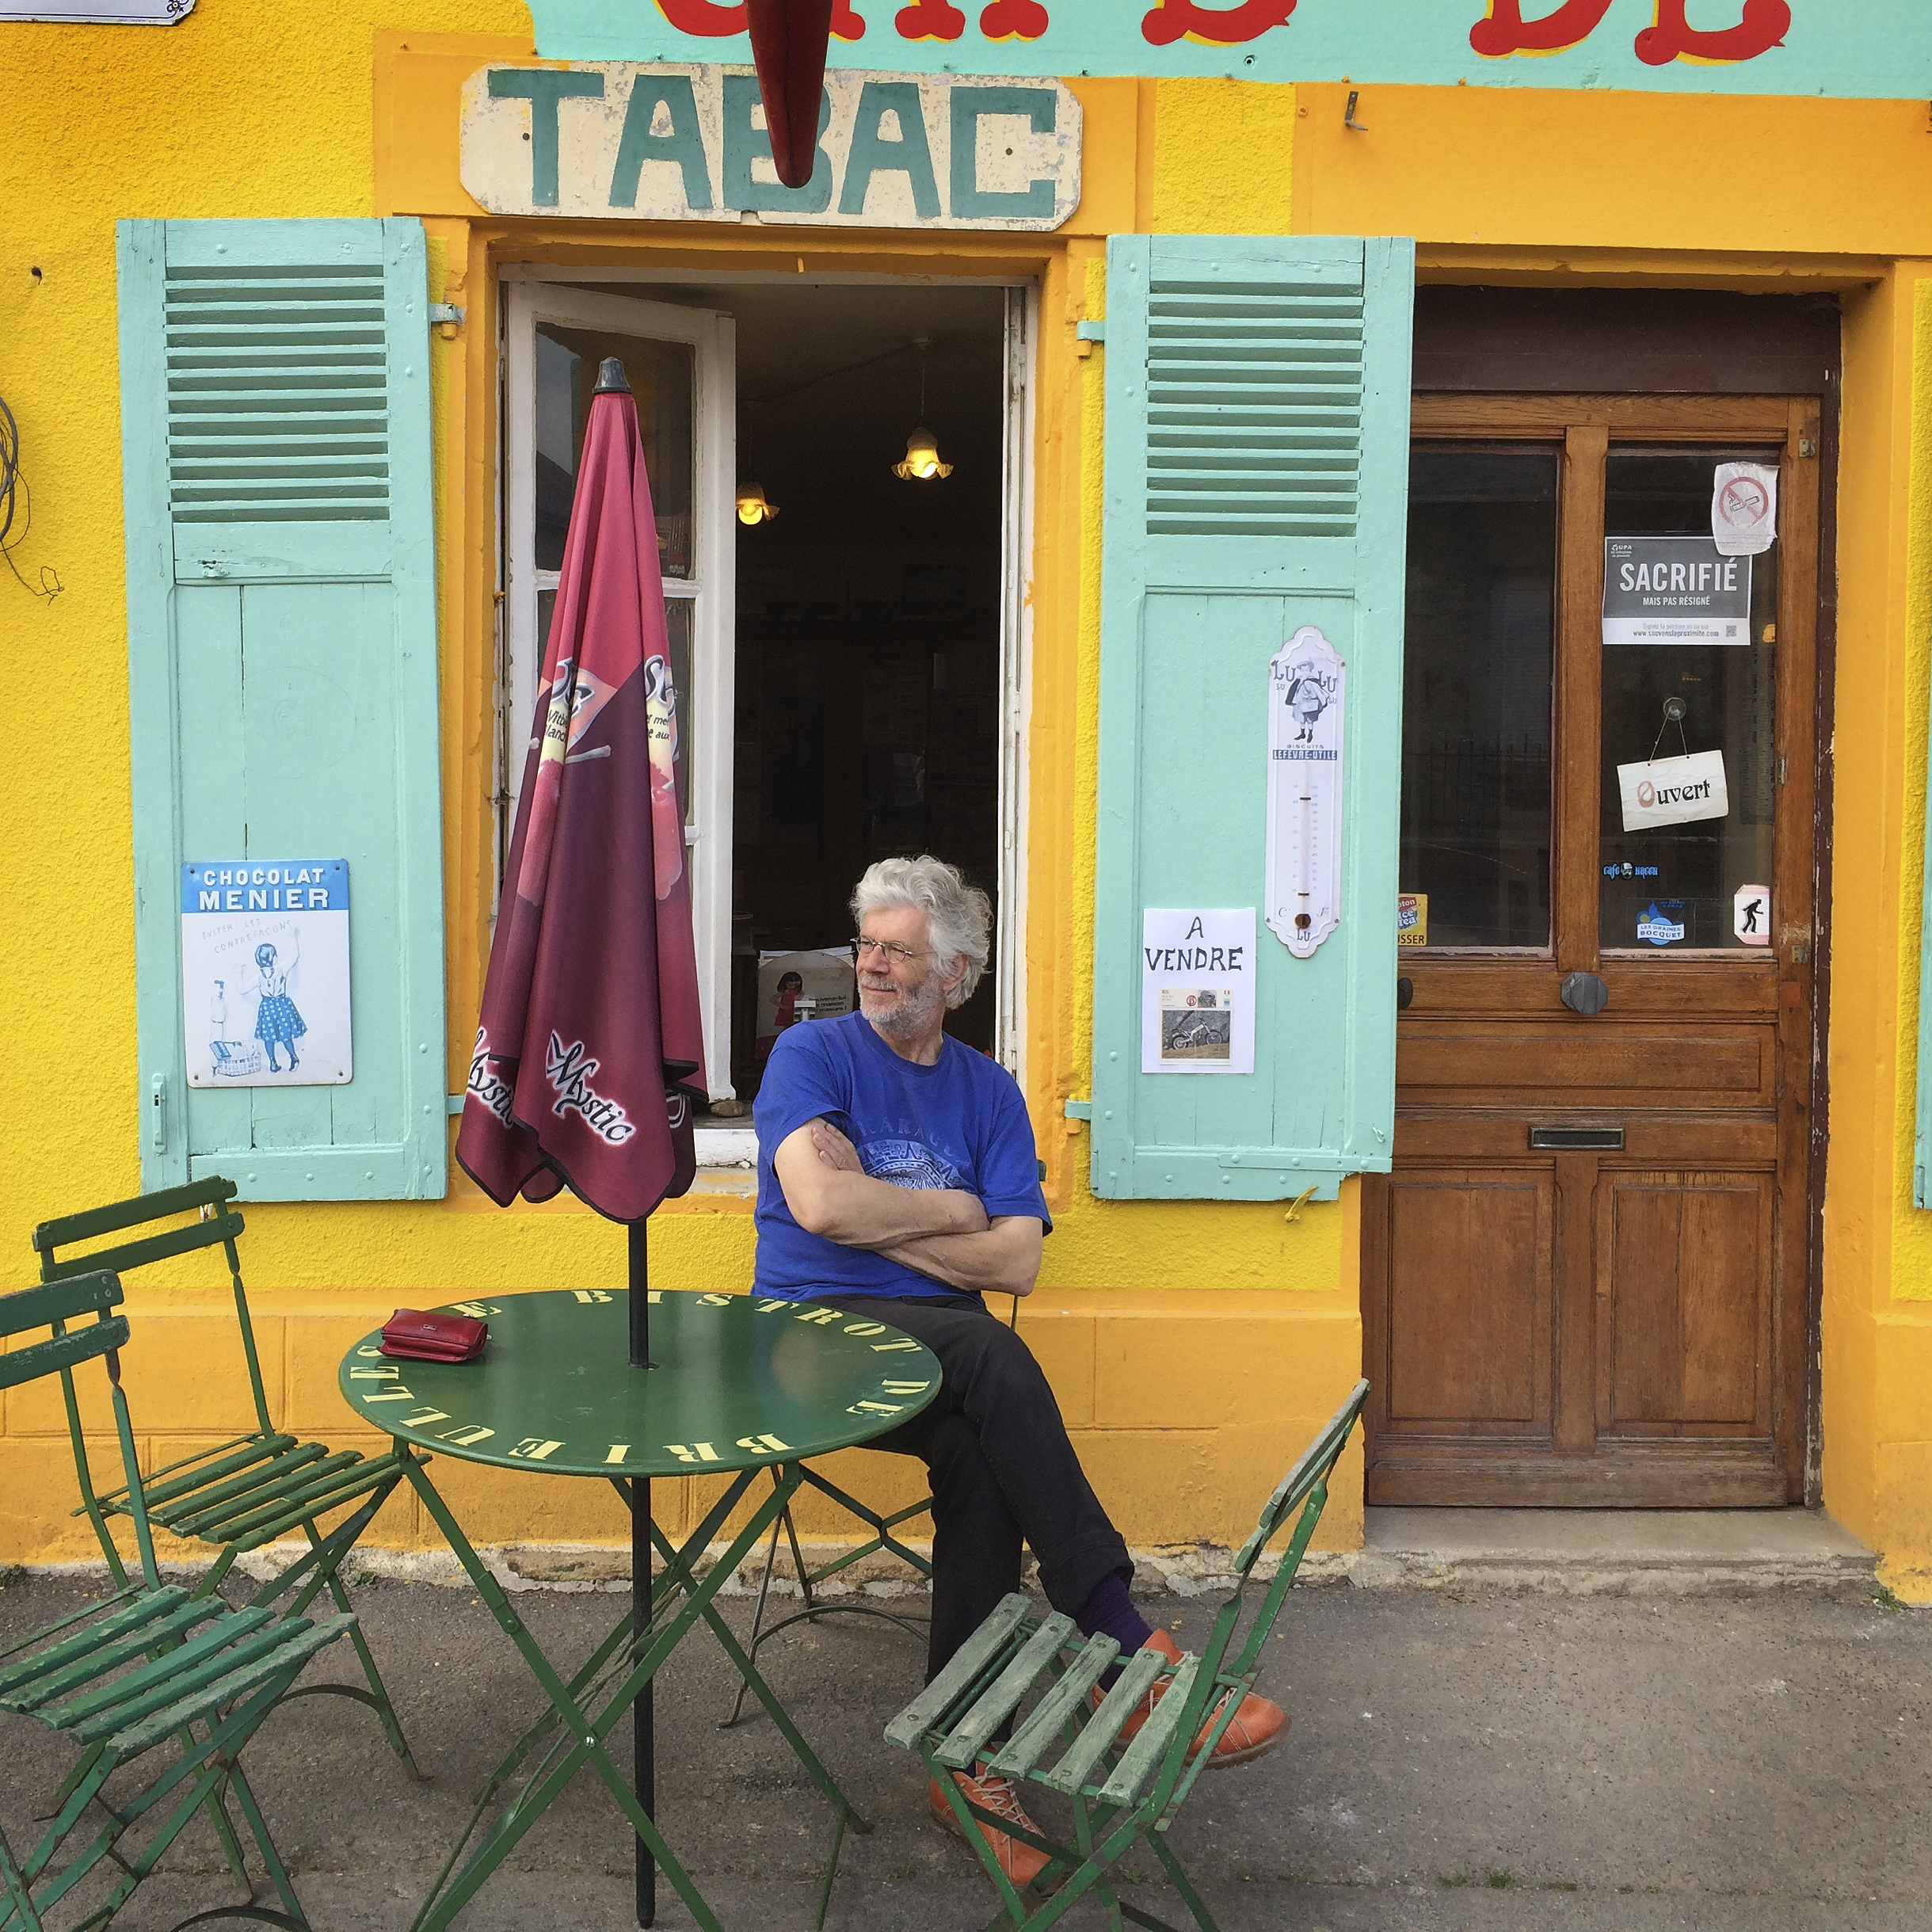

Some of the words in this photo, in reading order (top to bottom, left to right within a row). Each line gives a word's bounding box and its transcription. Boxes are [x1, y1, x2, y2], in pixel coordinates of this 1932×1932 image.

[487, 69, 1056, 219] TABAC
[1620, 557, 1738, 592] SACRIFIÉ
[1643, 597, 1661, 606] MAIS
[1663, 596, 1677, 606] PAS
[1679, 595, 1710, 606] RÉSIGNÉ
[1637, 779, 1711, 808] Ouvert
[204, 868, 325, 886] CHOCOLAT
[200, 888, 329, 910] MENIER
[1185, 916, 1204, 939] A
[1398, 935, 1424, 944] SSER
[1145, 946, 1243, 972] VENDRE
[546, 1031, 636, 1143] Mystic
